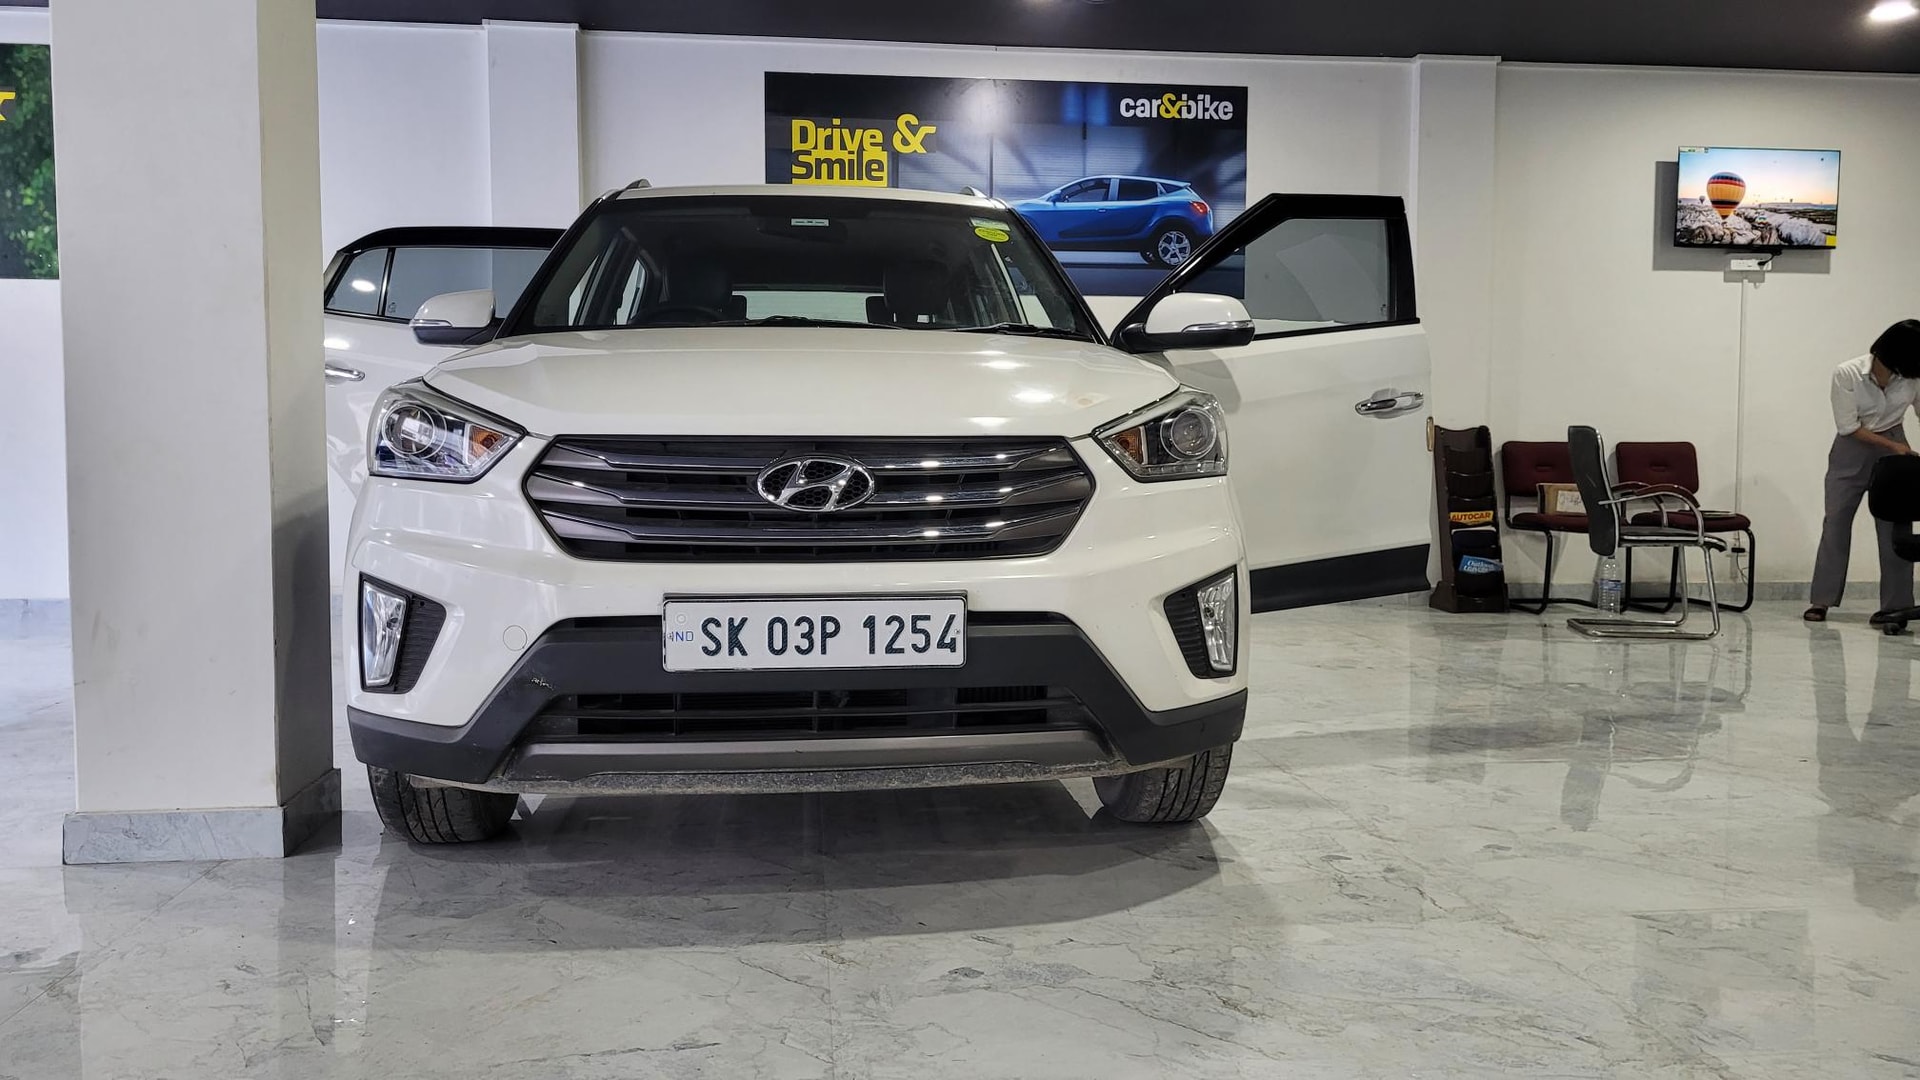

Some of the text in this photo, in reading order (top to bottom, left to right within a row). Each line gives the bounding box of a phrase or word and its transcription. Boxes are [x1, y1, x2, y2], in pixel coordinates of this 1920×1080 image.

[1119, 92, 1234, 121] car&bike
[792, 113, 937, 154] Drive &
[791, 150, 885, 182] Smile
[1452, 512, 1492, 521] AUTOCAR
[701, 616, 749, 657] SK
[766, 615, 842, 656] 03P
[862, 613, 958, 655] 1254
